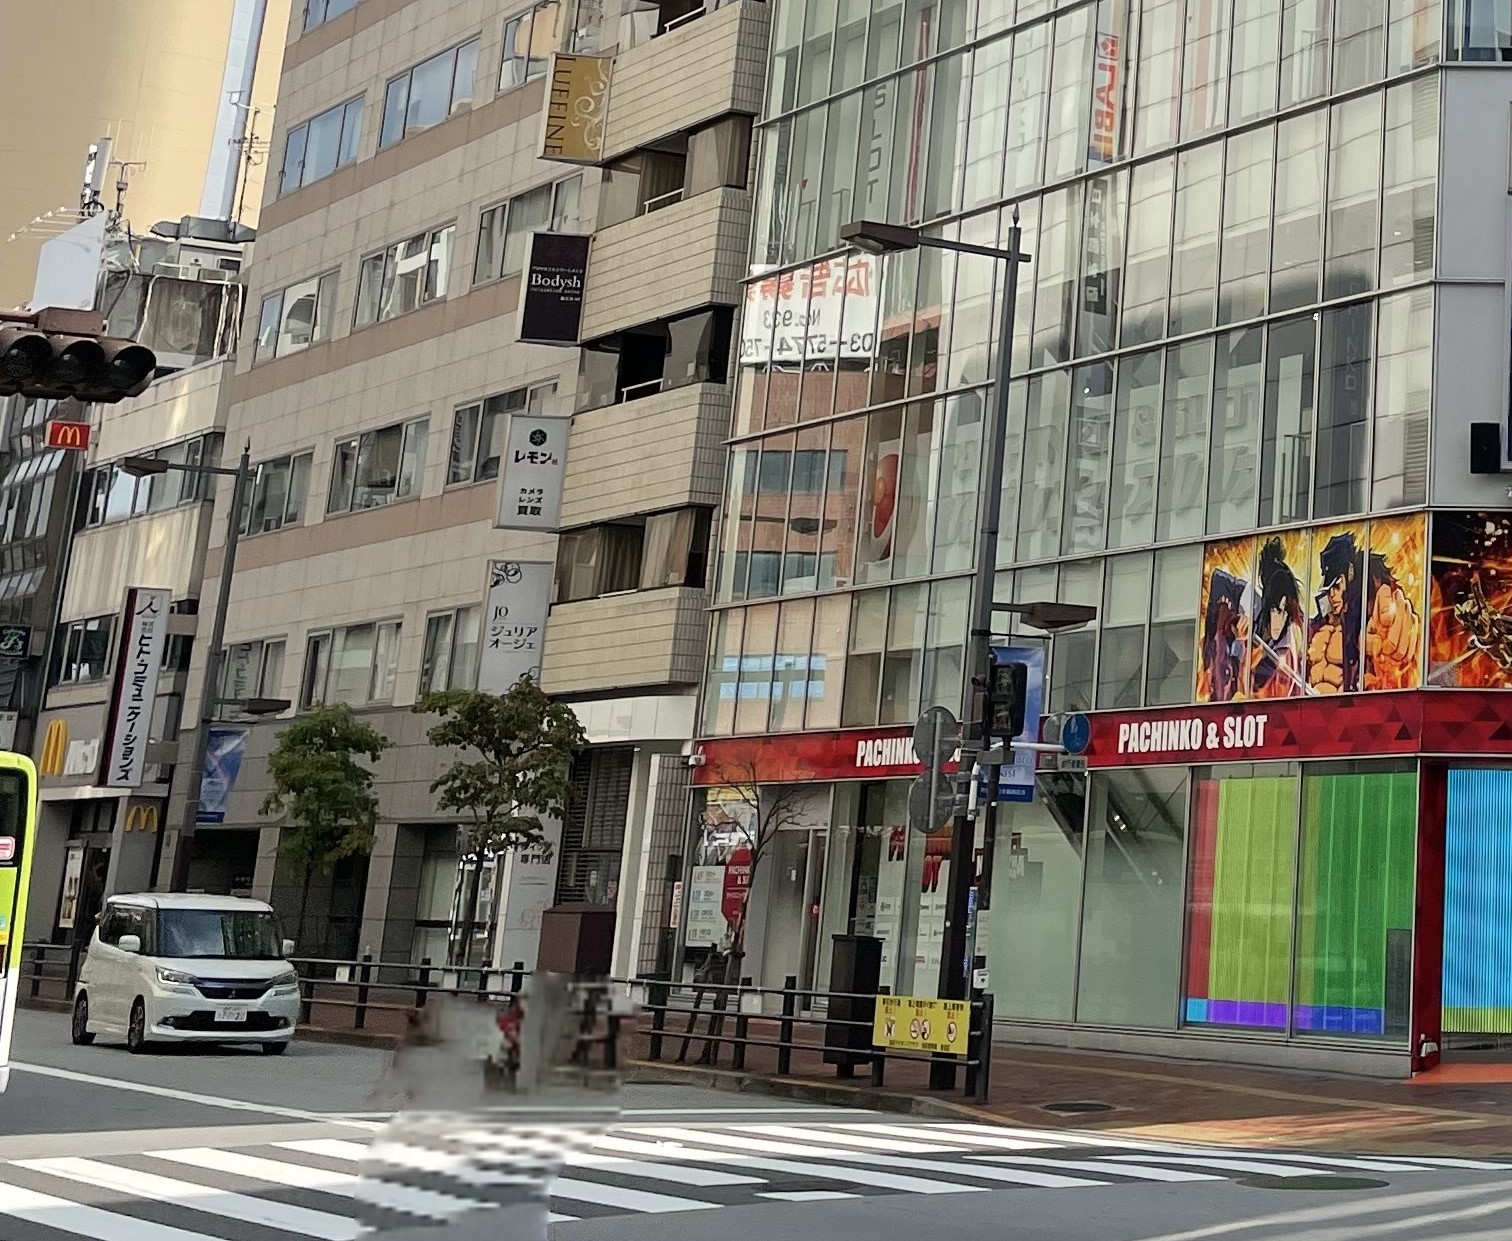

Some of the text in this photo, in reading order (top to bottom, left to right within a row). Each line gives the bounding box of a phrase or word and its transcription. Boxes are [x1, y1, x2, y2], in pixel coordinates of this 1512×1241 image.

[531, 273, 581, 291] Bodysh
[493, 606, 509, 621] JO
[490, 626, 538, 637] ジュリア
[489, 638, 536, 650] オージェ
[1118, 715, 1267, 753] PACHINKO & SLOT
